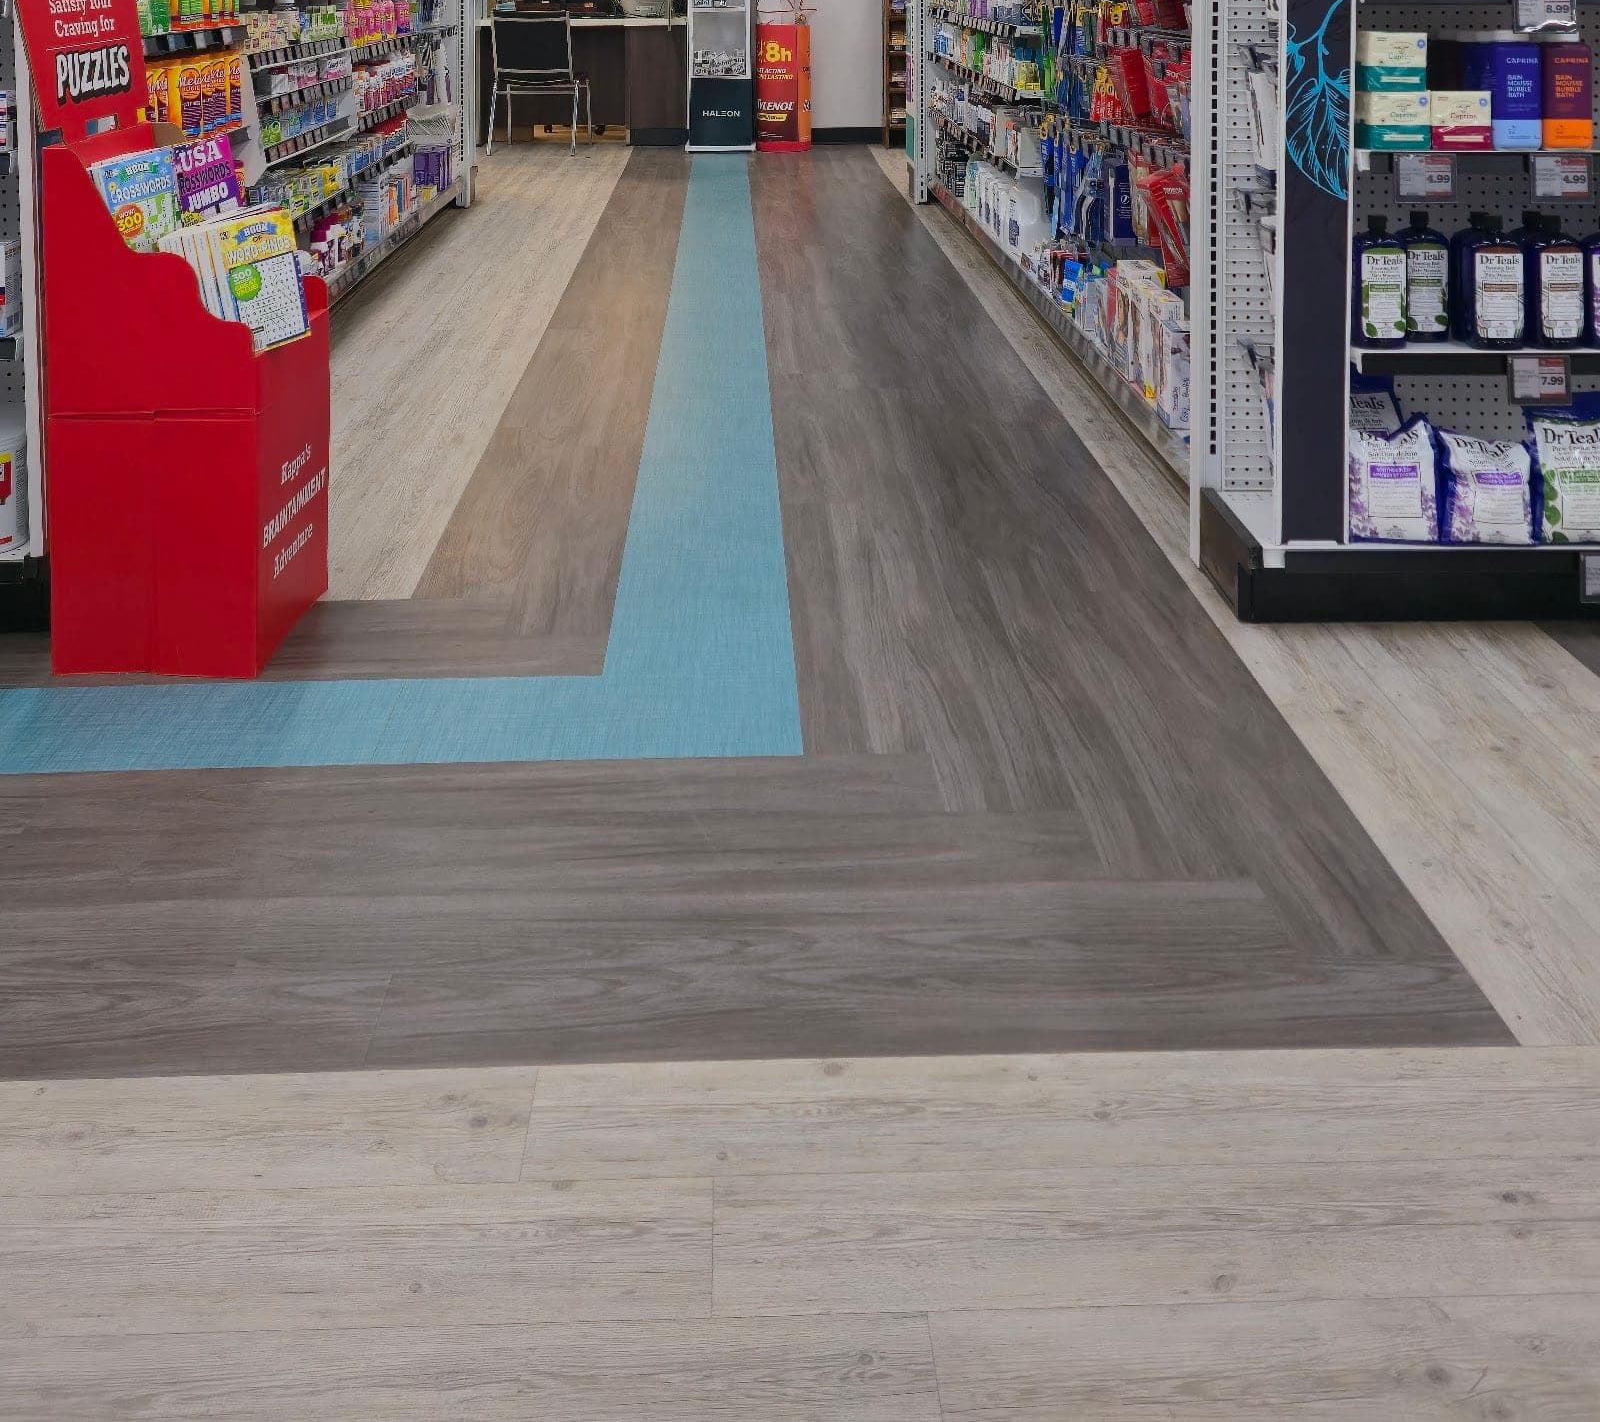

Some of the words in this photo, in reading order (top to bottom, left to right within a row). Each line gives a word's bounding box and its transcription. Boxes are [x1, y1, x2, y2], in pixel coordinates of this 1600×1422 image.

[1546, 4, 1570, 14] 8.99
[54, 17, 99, 38] Craving
[99, 14, 115, 32] for
[766, 42, 793, 63] 8h
[1506, 57, 1539, 65] CAPRINA
[1554, 57, 1589, 65] CAPRINA
[56, 45, 131, 102] PUZZLES
[180, 139, 222, 170] USA
[125, 162, 150, 175] BOOK
[1426, 174, 1450, 184] 4.99
[1562, 174, 1587, 184] 4.99
[110, 176, 171, 204] CROSSWORDS
[188, 182, 229, 212] JUMBO
[117, 213, 142, 231] 300
[243, 222, 268, 237] BOOK
[253, 234, 264, 243] OF
[1366, 255, 1380, 265] Dr
[1381, 254, 1403, 266] Teal's
[1408, 251, 1421, 260] Dr
[1422, 250, 1445, 261] Teal's
[1480, 255, 1494, 265] Dr
[1495, 254, 1520, 266] Teal's
[1546, 255, 1559, 265] Dr
[1560, 254, 1581, 266] Teal's
[234, 268, 252, 282] 300
[1541, 376, 1564, 386] 7.99
[1351, 396, 1385, 410] Teal's
[1453, 437, 1473, 449] Dr
[1542, 427, 1564, 445] Dr
[280, 443, 311, 486] Kappa's
[262, 467, 326, 550] BRAINTAINMENT
[273, 523, 314, 579] Adventure
